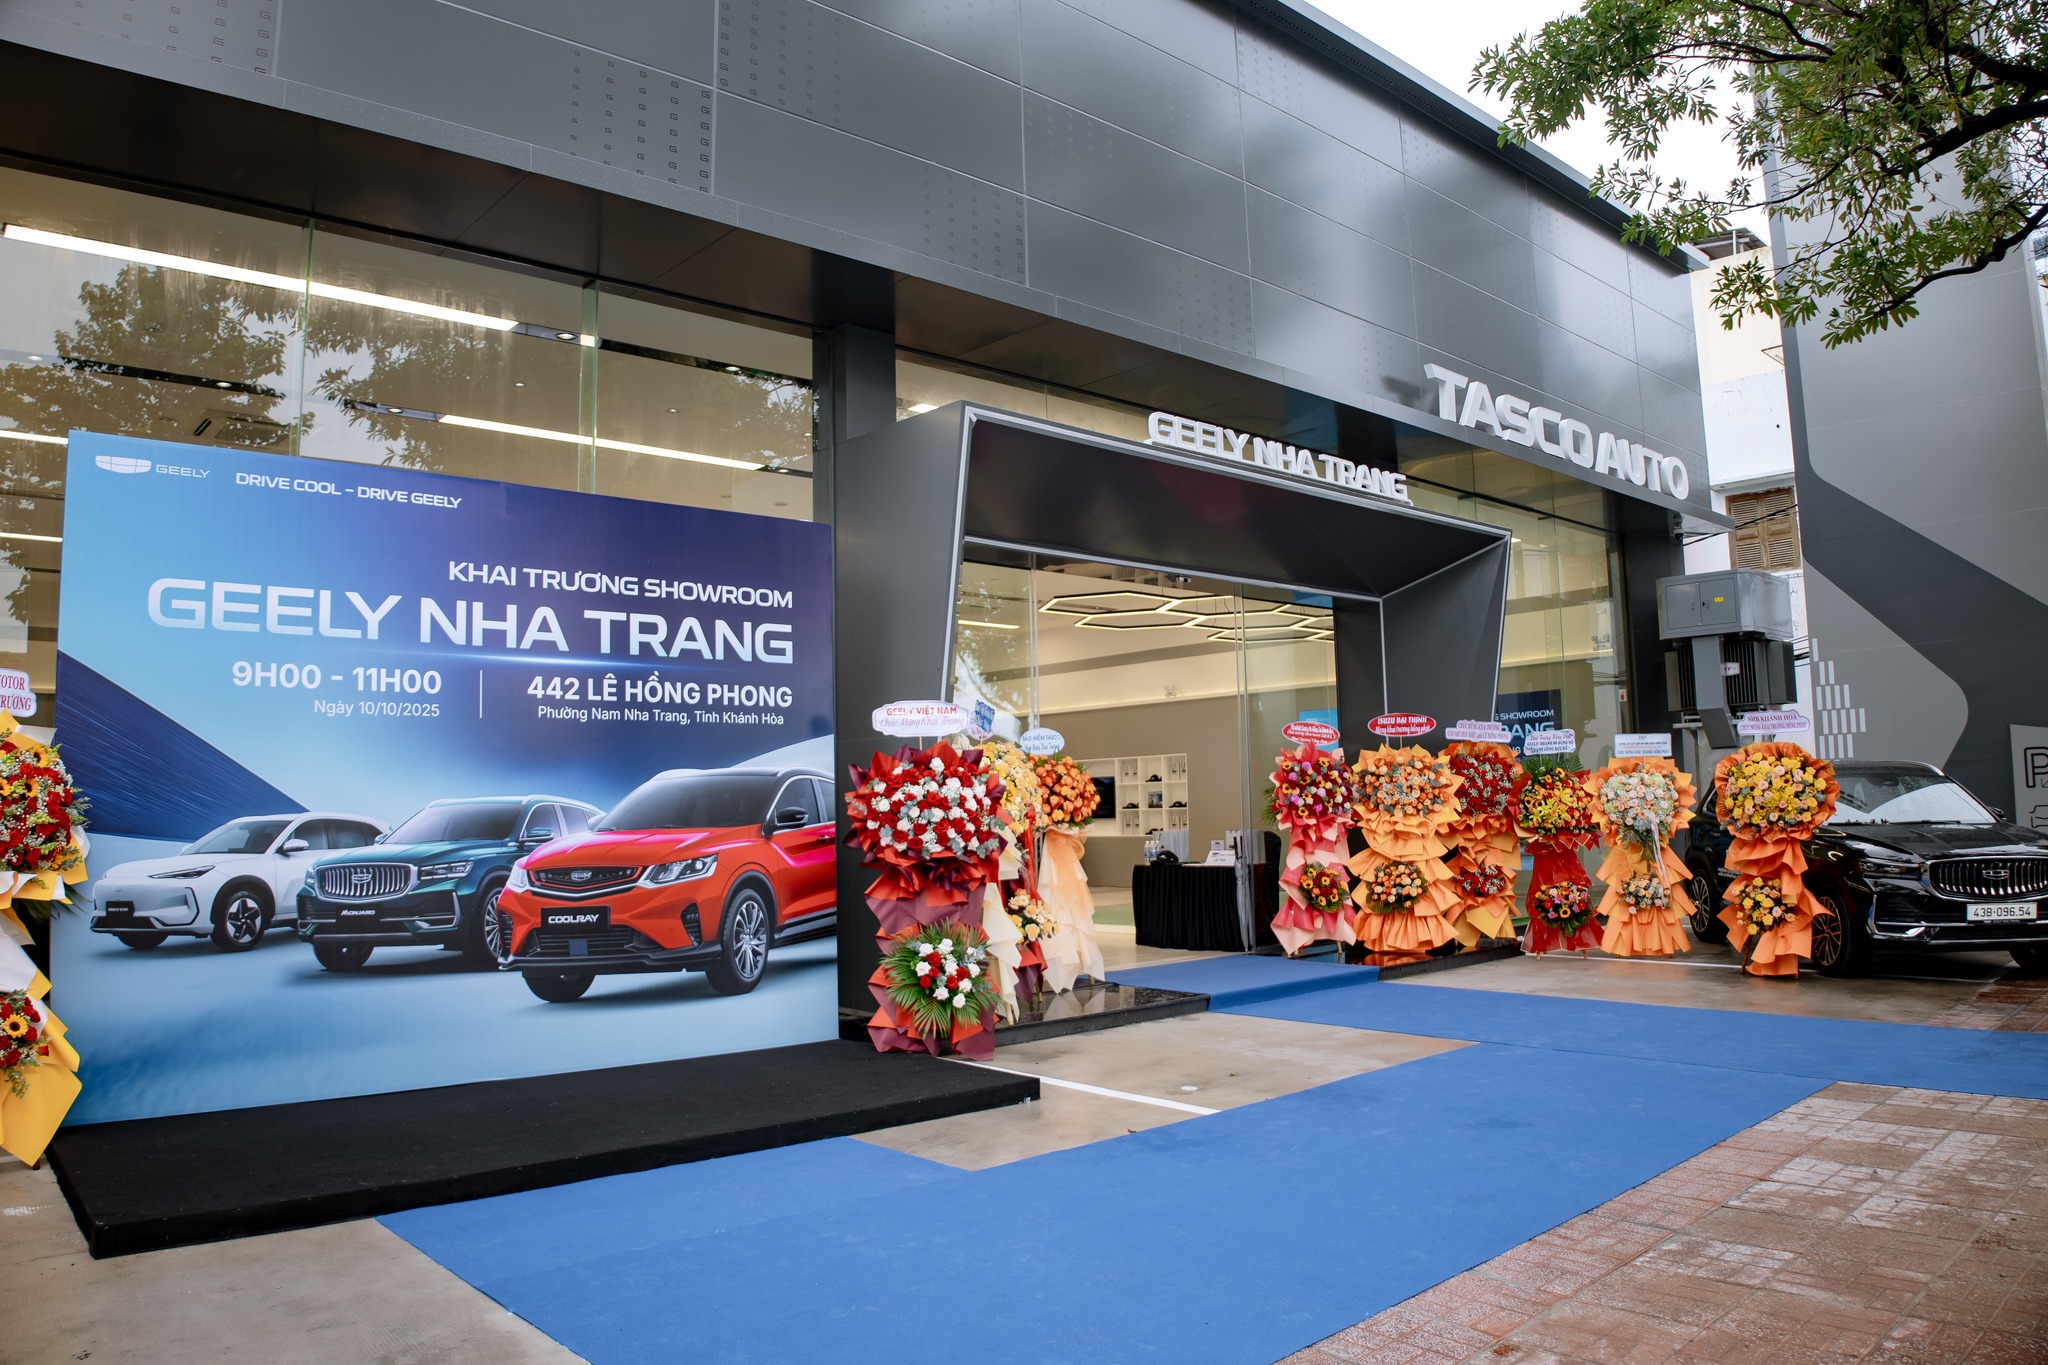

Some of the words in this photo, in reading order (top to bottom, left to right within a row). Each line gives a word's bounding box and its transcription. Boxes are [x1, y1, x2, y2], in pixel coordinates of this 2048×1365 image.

[1423, 362, 1595, 469] TASCO
[1594, 431, 1690, 500] AUTO
[1148, 411, 1250, 461] GEELY
[1252, 436, 1319, 479] NHA
[1318, 453, 1409, 500] TRANG
[155, 464, 211, 479] GEELY
[235, 472, 290, 490] DRIVE
[293, 479, 342, 496] COOL
[357, 486, 408, 503] DRIVE
[410, 492, 462, 509] GEELY
[449, 561, 516, 586] KHAI
[522, 567, 639, 596] TRƯƠNG
[644, 578, 793, 609] SHOWROOM
[148, 577, 403, 641] GEELY
[420, 597, 569, 652] NHA
[583, 609, 793, 664] TRANG
[0, 674, 26, 691] OTOR
[232, 660, 322, 690] 9H00
[352, 666, 442, 694] 11H00
[527, 675, 580, 700] 442
[587, 673, 618, 701] LÊ
[624, 670, 701, 705] HỒNG
[707, 683, 793, 708] PHONG
[313, 699, 354, 717] Ngày
[358, 701, 440, 718] 10/10/2025
[538, 705, 588, 723] Phường
[591, 707, 621, 720] Nam
[624, 708, 650, 721] Nha
[652, 709, 691, 725] Trang,
[722, 711, 759, 725] Khánh
[761, 712, 785, 725] Hòa
[916, 705, 936, 716] VIỆT
[937, 706, 958, 715] NAM
[1500, 709, 1555, 720] SHOWROOM
[548, 914, 600, 924] COOLRAY
